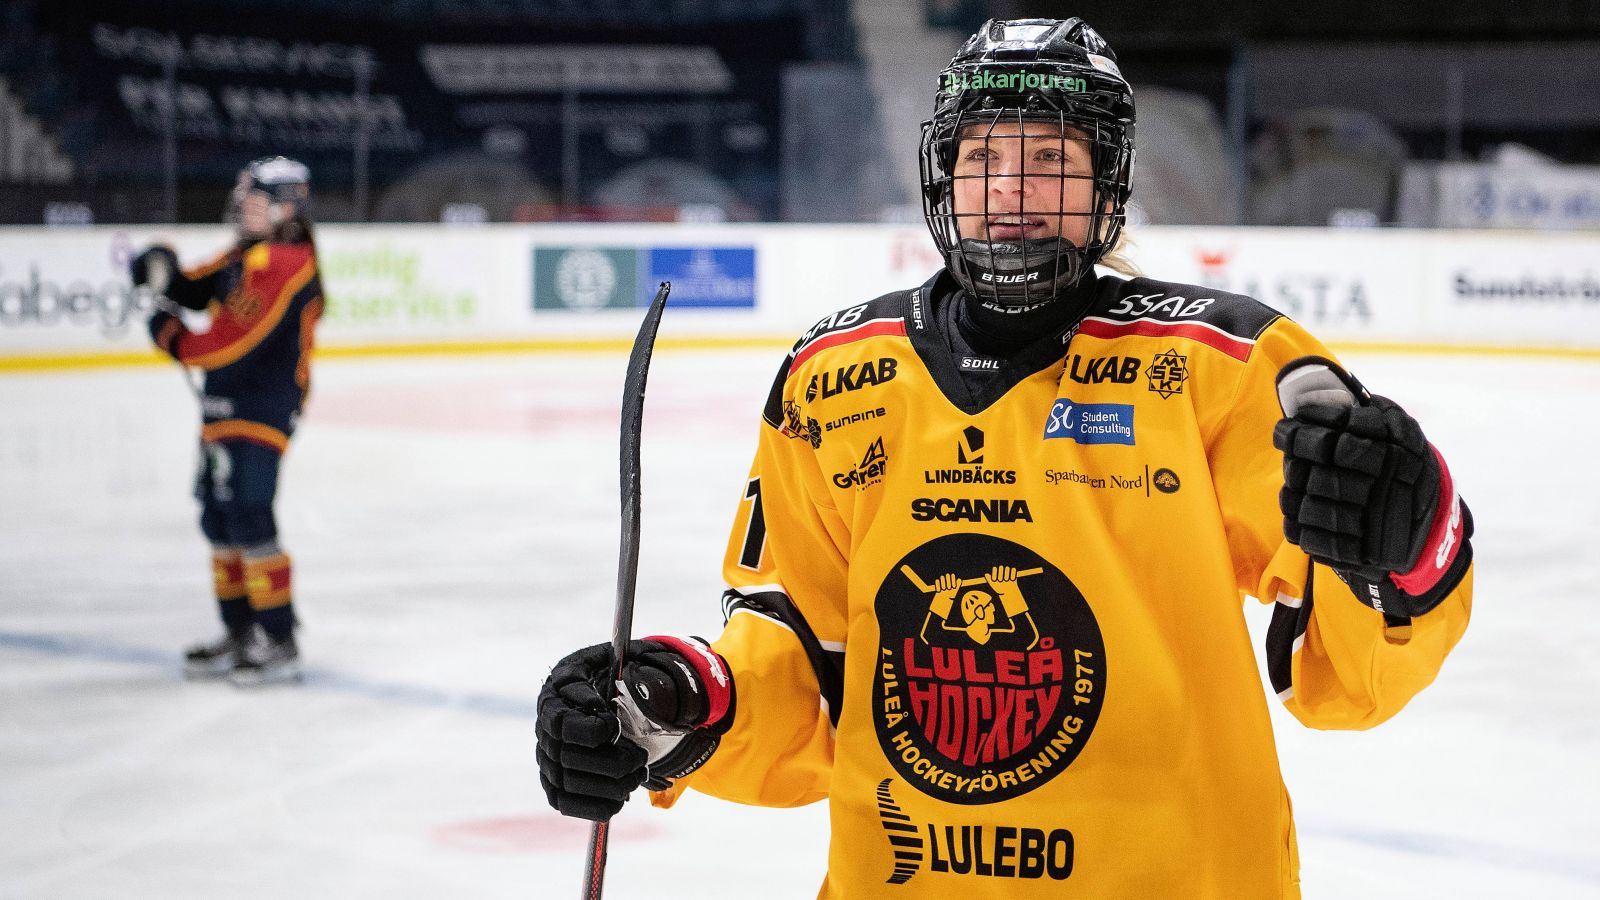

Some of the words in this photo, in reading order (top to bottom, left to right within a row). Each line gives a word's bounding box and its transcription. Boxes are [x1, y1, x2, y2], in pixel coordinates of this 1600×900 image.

[962, 69, 1087, 94] Läkarjouren
[982, 272, 1039, 283] BAUER
[911, 289, 924, 330] BAUER
[1108, 293, 1215, 318] SSAB
[961, 356, 1000, 370] SDHL
[1069, 354, 1142, 385] LKAB
[821, 357, 898, 400] LKAB
[1080, 423, 1131, 437] Consulting
[1081, 411, 1119, 422] Student
[925, 466, 1017, 485] LINDBÄCKS
[1110, 475, 1143, 489] Nord
[911, 498, 1034, 523] SCANIA
[904, 636, 1064, 686] LULEÅ
[882, 647, 909, 729] LULEÅ
[1073, 648, 1093, 706] 1977
[908, 681, 1063, 767] HOCKEY
[891, 715, 1084, 794] HOCKEYFÖRENING
[928, 823, 1075, 881] LULEBO
